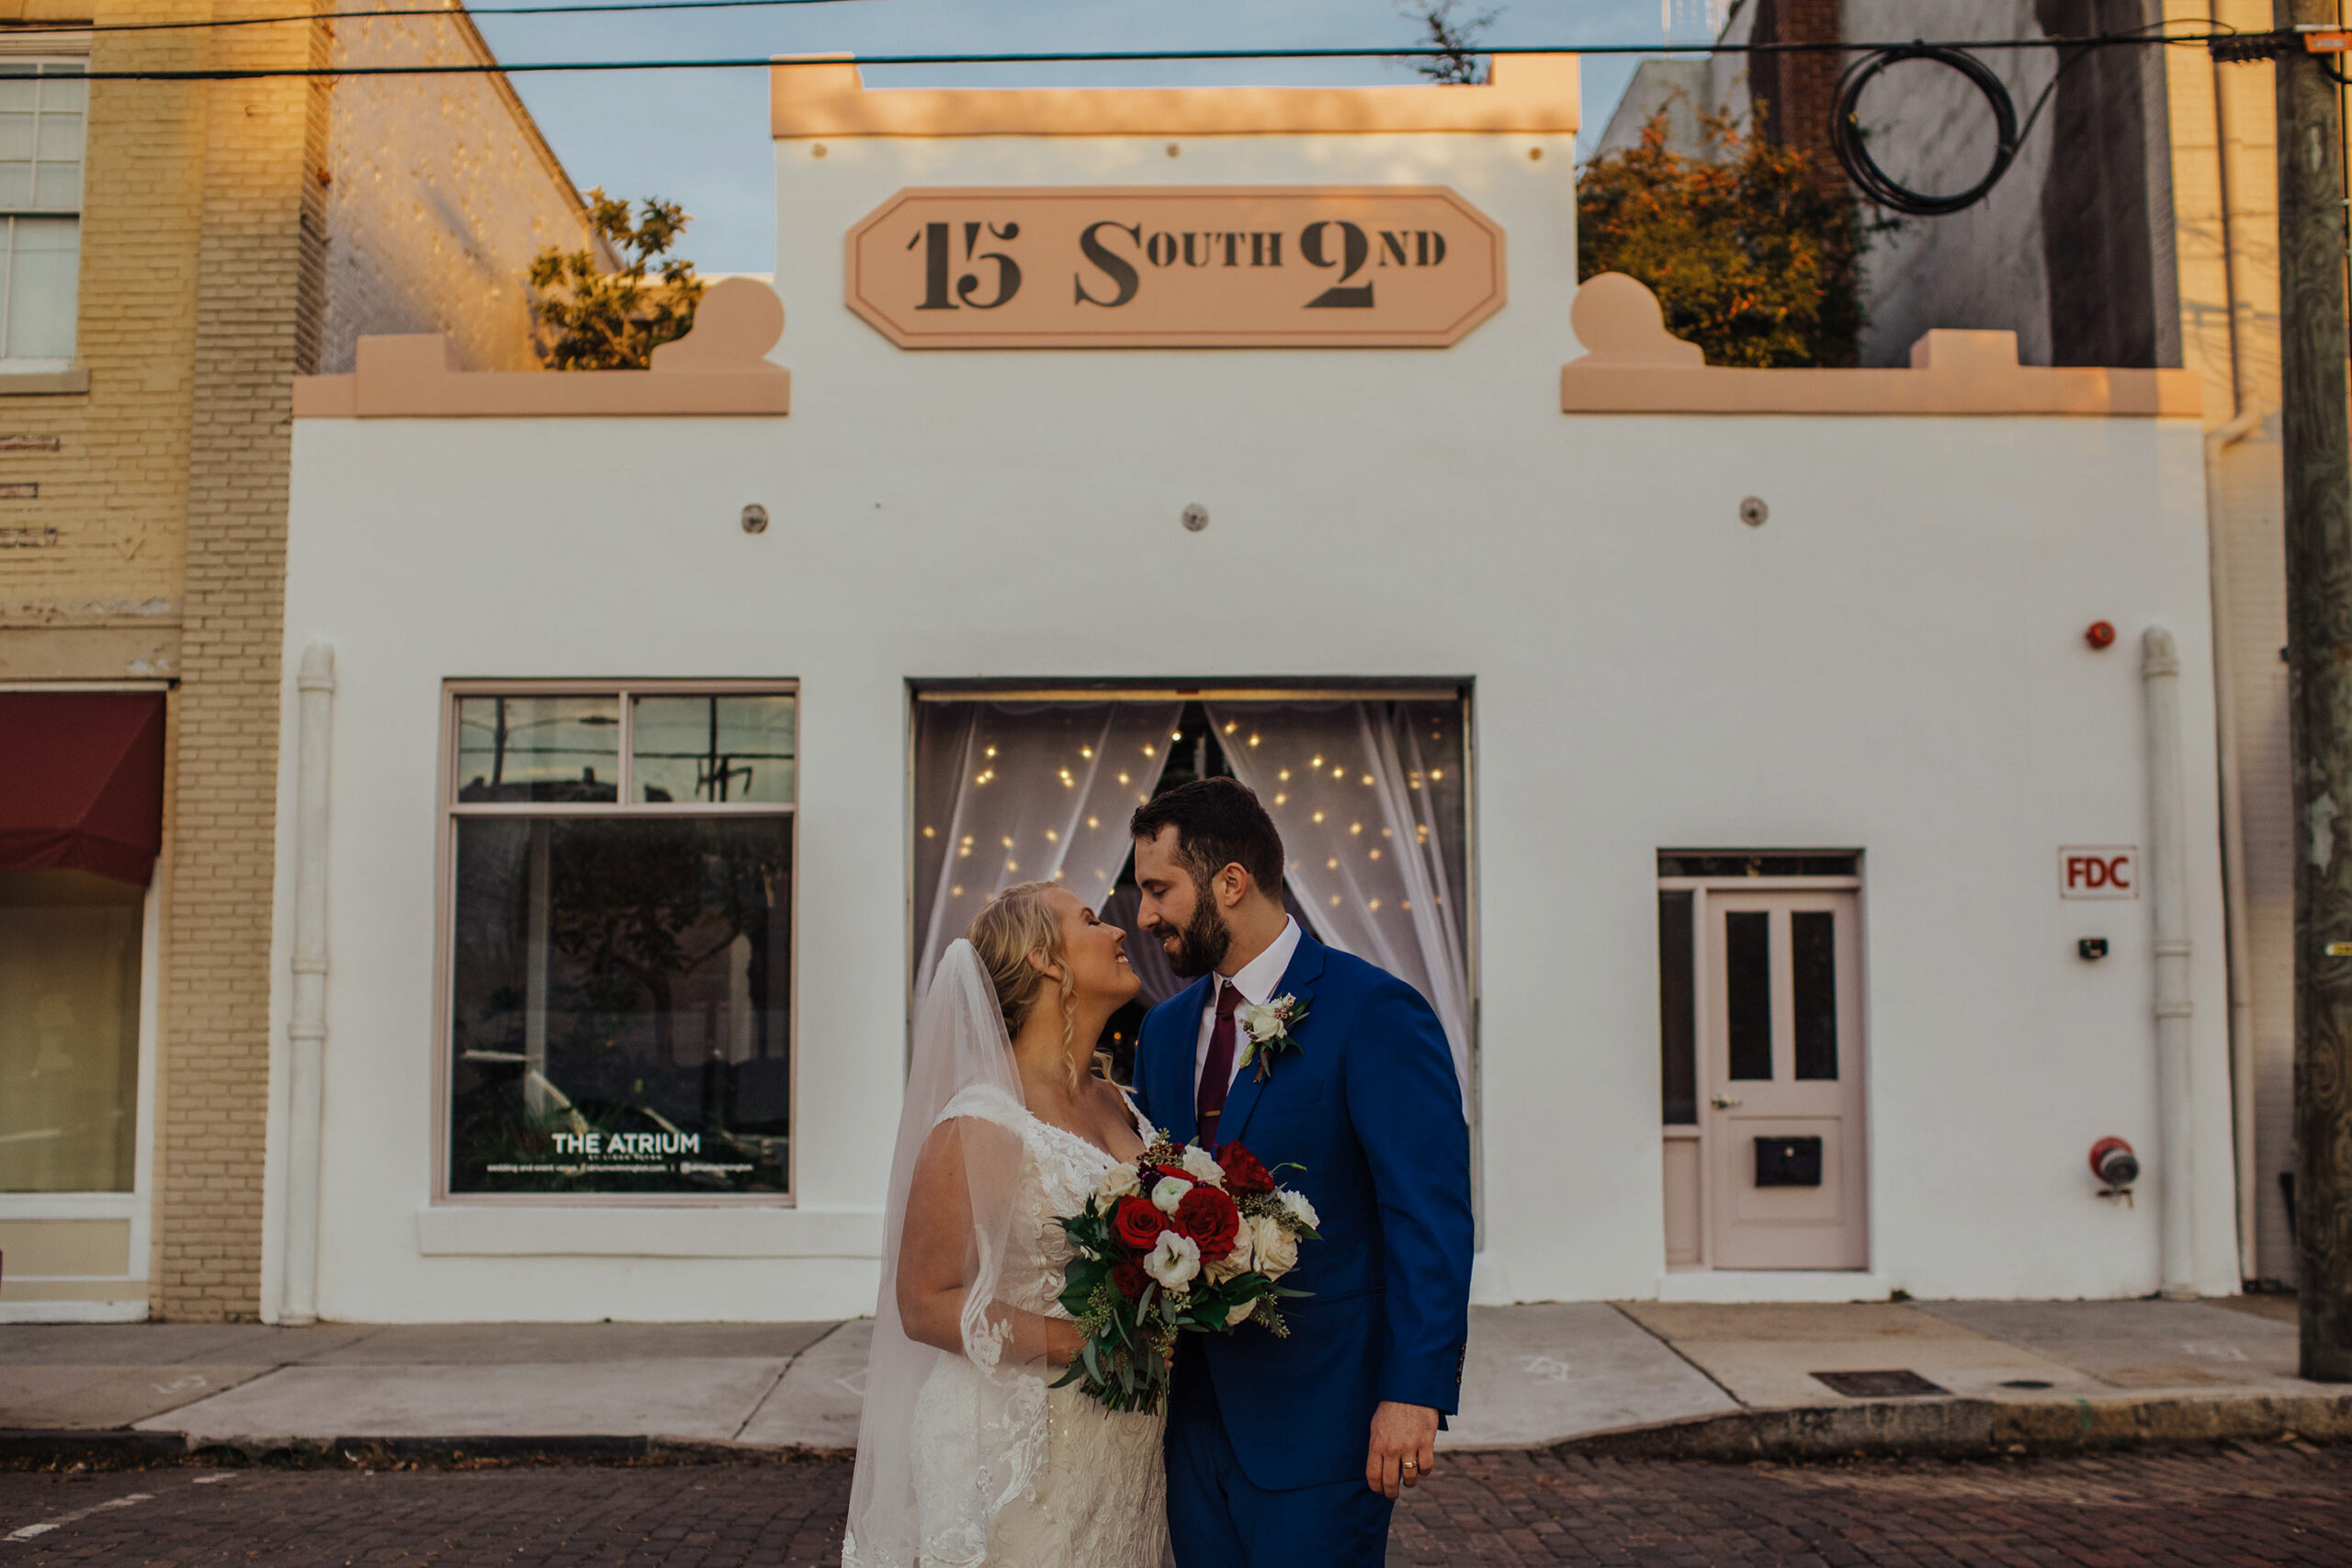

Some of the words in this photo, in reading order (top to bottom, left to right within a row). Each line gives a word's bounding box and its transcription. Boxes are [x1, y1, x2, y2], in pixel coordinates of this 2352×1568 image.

[907, 221, 1022, 310] 15
[2067, 856, 2130, 888] FDC
[551, 1133, 601, 1154] THE
[607, 1133, 700, 1154] ATRIUM
